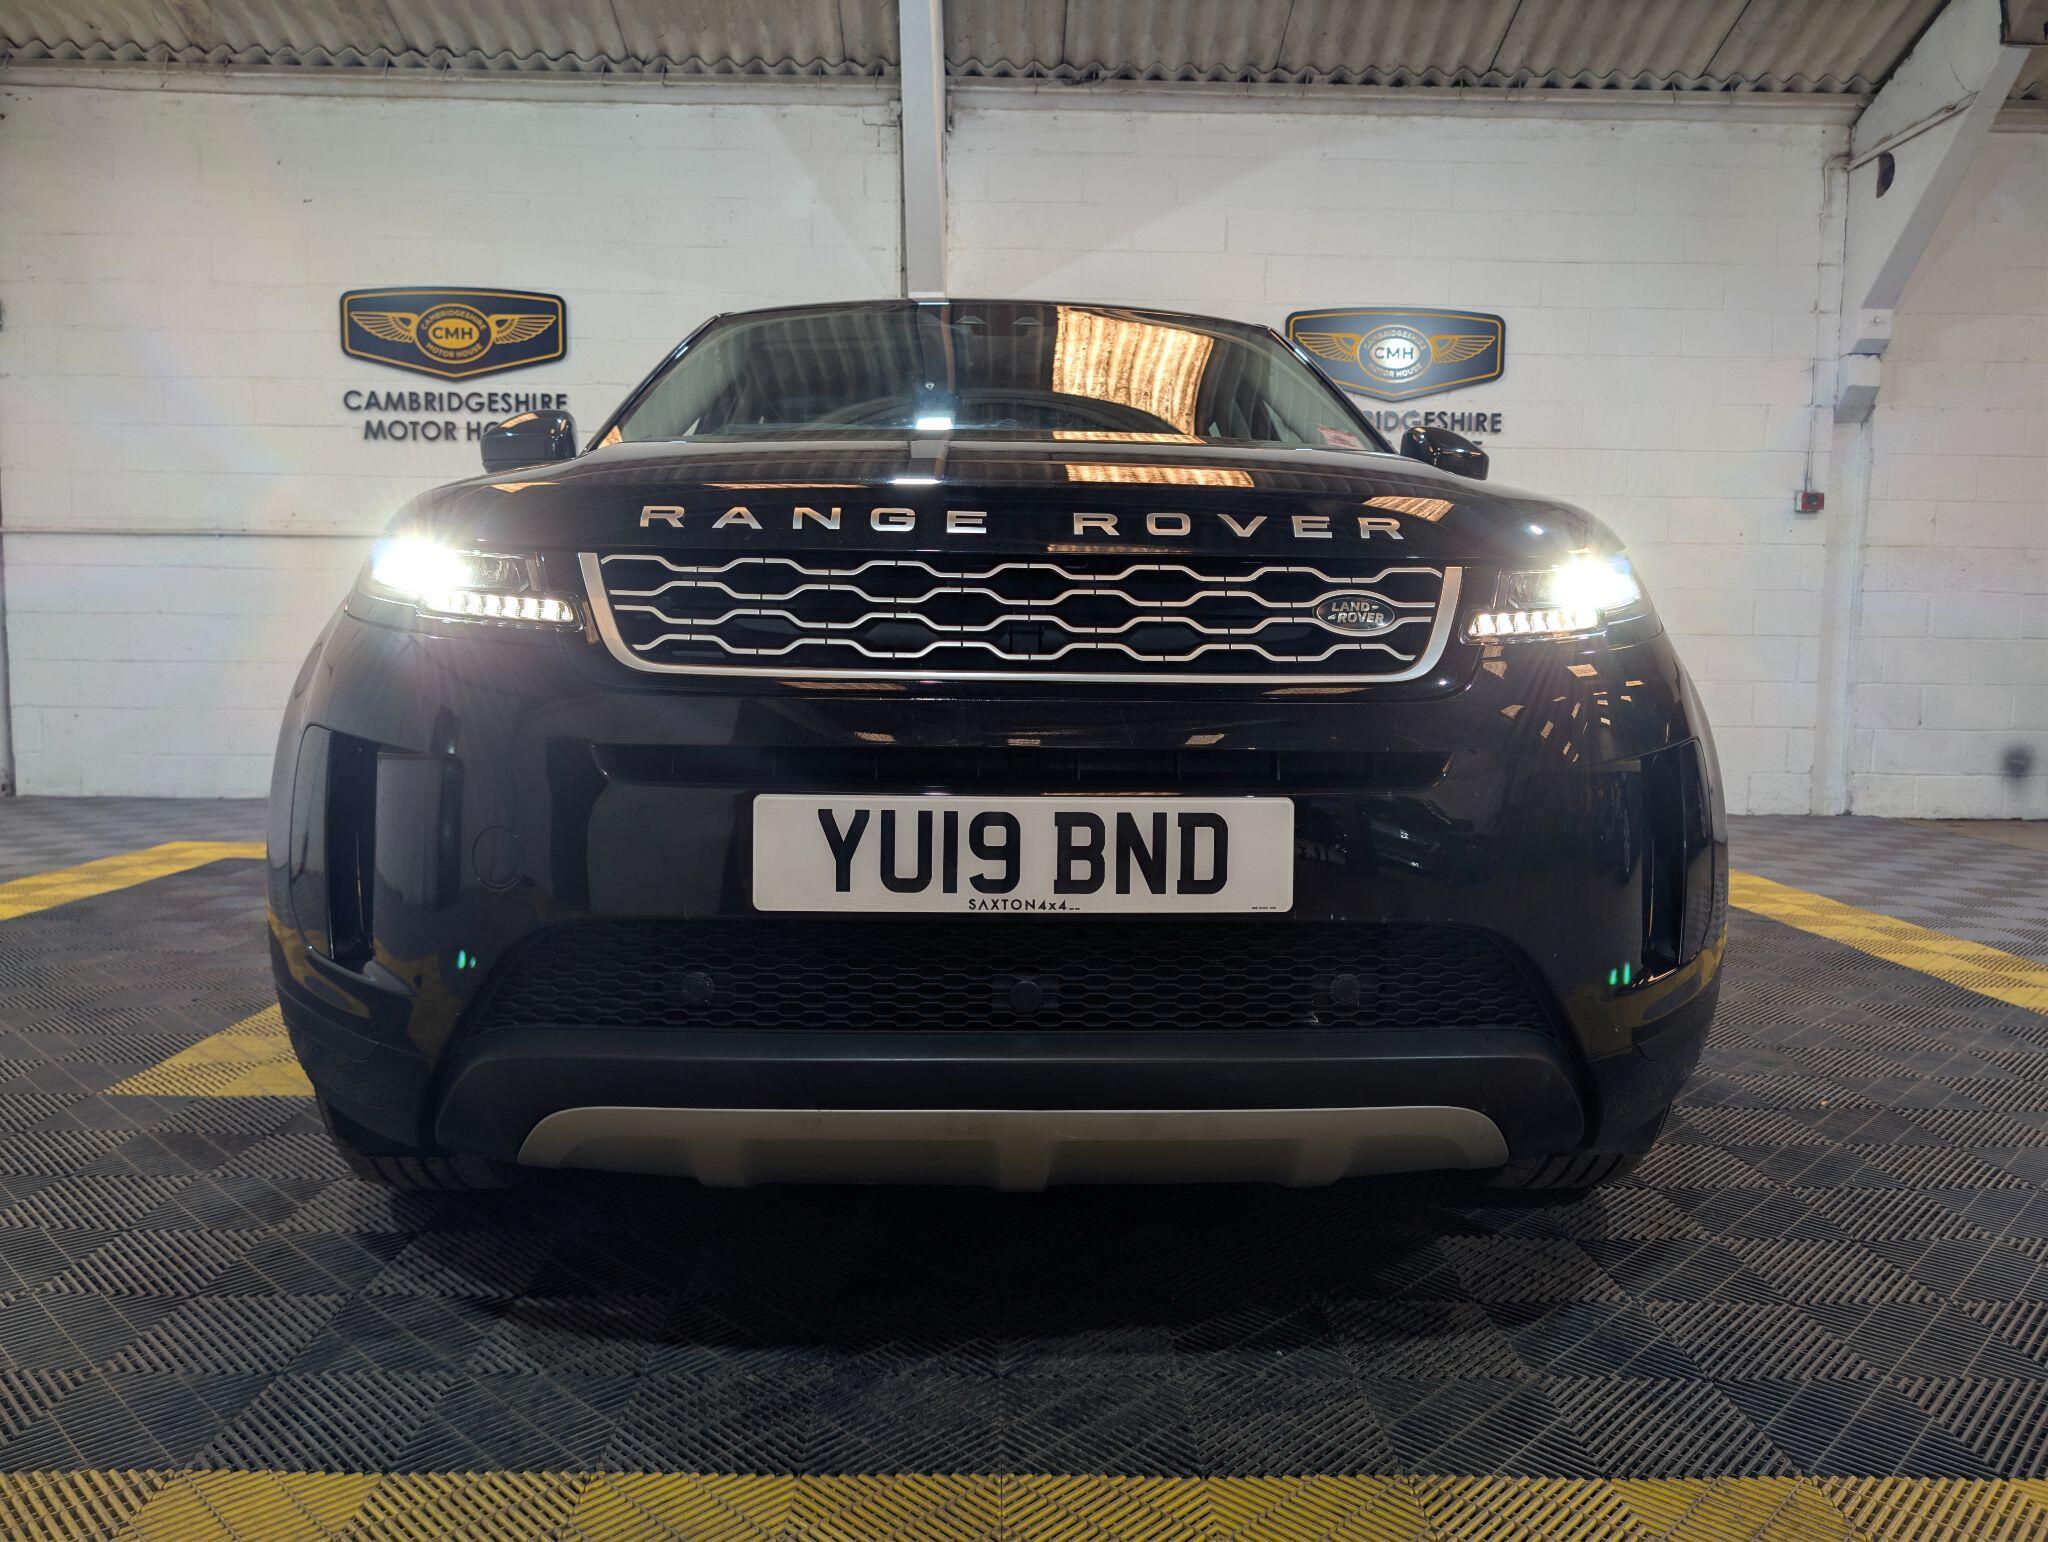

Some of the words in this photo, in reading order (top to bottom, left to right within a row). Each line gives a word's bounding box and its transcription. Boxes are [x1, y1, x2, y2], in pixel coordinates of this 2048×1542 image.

[421, 309, 487, 331] CAMBRIDGESHIRE
[432, 326, 473, 340] CMH
[426, 342, 455, 358] MOTOR
[456, 342, 483, 358] HOUSE
[1374, 346, 1414, 360] CMH
[363, 419, 458, 441] MOTOR
[639, 505, 988, 534] RANGE
[1072, 511, 1405, 541] ROVER
[1331, 601, 1370, 612] LAND
[1336, 612, 1385, 624] ROVER
[817, 808, 1022, 895] YU19
[1053, 811, 1230, 896] BND
[968, 898, 1067, 911] SAXTON4x4
